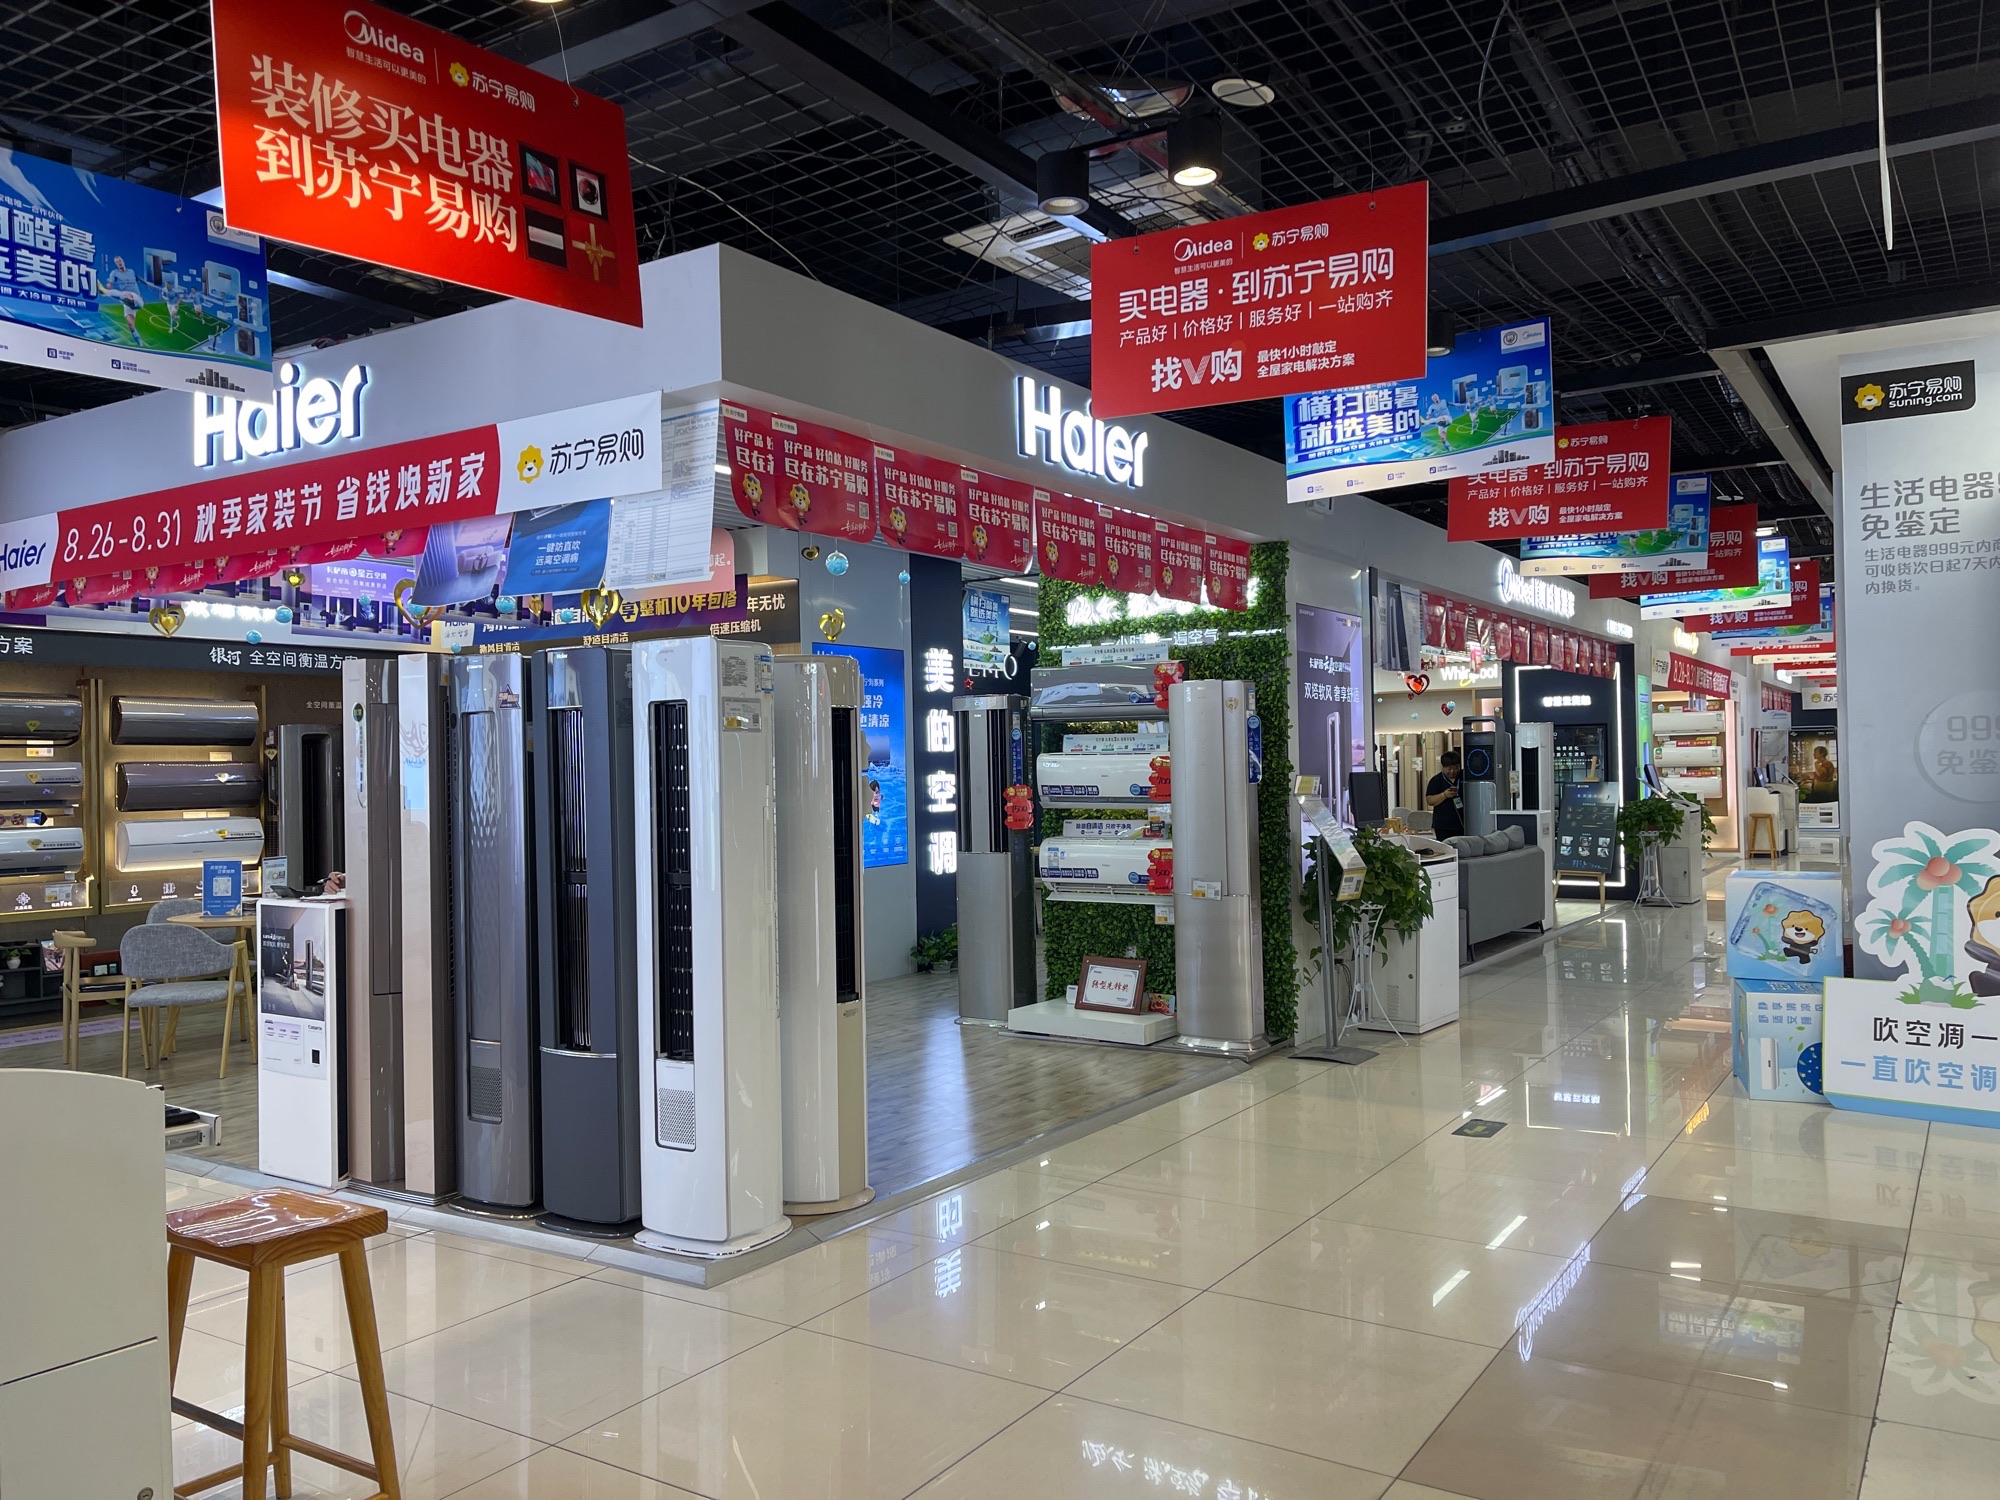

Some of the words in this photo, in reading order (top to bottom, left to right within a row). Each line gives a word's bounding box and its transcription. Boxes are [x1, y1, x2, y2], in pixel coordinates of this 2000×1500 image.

[343, 10, 425, 64] Midea
[346, 46, 427, 85] 智慧生活可以更美的
[472, 71, 536, 112] 苏宁易购
[249, 54, 515, 193] 装修买电器
[255, 124, 518, 253] 到苏宁易购
[1271, 222, 1329, 247] 苏宁易购
[1174, 237, 1233, 262] Midea
[1175, 258, 1233, 275] 智慧生活可以更美的
[1119, 247, 1394, 323] 买电器·到苏宁易购
[1119, 326, 1167, 348] 产品好
[1182, 314, 1233, 338] 价格好
[1249, 303, 1302, 328] 服务好
[1318, 289, 1393, 314] 一站购齐
[1257, 340, 1337, 362] 最快1小时敲定
[1151, 347, 1243, 393] 找V购
[1257, 353, 1355, 378] 全屋家电解决方案
[1889, 375, 1962, 400] 苏宁易购
[1889, 392, 1962, 408] suning.com
[194, 362, 369, 467] Haier
[1299, 386, 1419, 422] 横扫酷暑
[734, 427, 764, 447] 好产品
[1016, 377, 1149, 488] Haier
[1300, 409, 1420, 449] 就选美的
[1570, 435, 1608, 447] 苏宁易购
[549, 427, 645, 476] 苏宁易购
[784, 439, 813, 459] 好产品
[815, 447, 842, 466] 好价格
[844, 455, 868, 474] 好服务
[785, 457, 868, 496] 尽在苏宁易购
[884, 466, 907, 484] 好产品
[885, 482, 957, 517] 尽在苏宁易购
[968, 488, 989, 502] 好产品
[1860, 471, 2000, 510] 生活电器
[0, 539, 46, 573] Haier
[64, 508, 181, 562] 8.26-8.31
[194, 482, 322, 544] 秋季家装节
[336, 451, 485, 521] 省钱焕新家
[969, 503, 1030, 534] 尽在苏宁易购
[1041, 507, 1060, 521] 好产品
[1488, 504, 1550, 528] 找V购
[1559, 503, 1611, 514] 最快1小时敲定
[1042, 520, 1096, 548] 尽在苏宁易购
[1861, 507, 1960, 541] 免鉴定
[535, 553, 579, 566] 远离空调病
[538, 541, 581, 553] 一键防直吹
[1105, 536, 1152, 561] 尽在苏宁易购
[1621, 570, 1668, 588] 找V购
[1865, 556, 2000, 578] 可收货次日起7天内
[1866, 579, 1920, 594] 内换货。
[747, 594, 786, 612] 年无忧
[710, 619, 761, 636] 倍速压缩机
[209, 647, 242, 666] 银河
[249, 651, 358, 670] 全空间衡温方
[1441, 663, 1498, 683] Whirool
[1304, 682, 1332, 701] 双塔软风
[1947, 715, 2000, 742] 99
[925, 648, 957, 876] 美的空调
[1937, 748, 1999, 775] 免鉴
[1841, 1055, 1997, 1093] 一直吹空调
